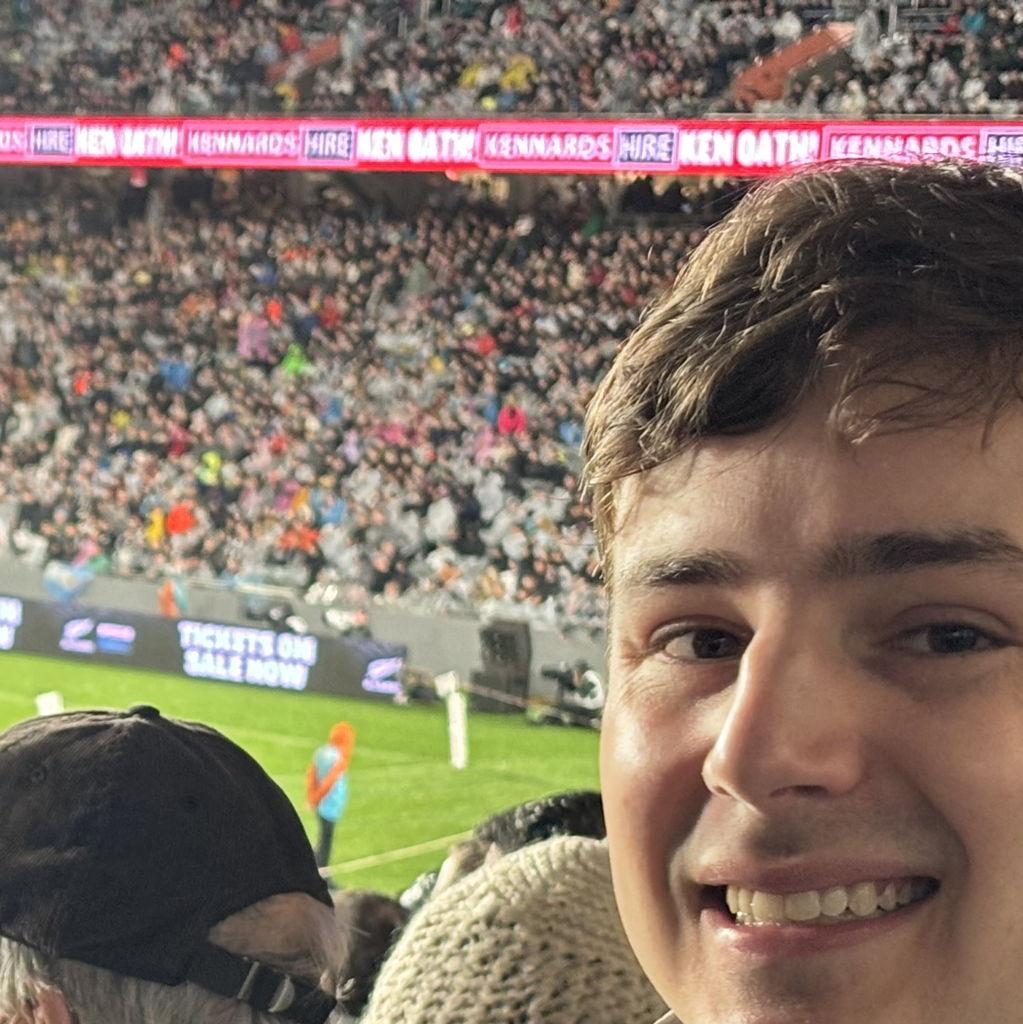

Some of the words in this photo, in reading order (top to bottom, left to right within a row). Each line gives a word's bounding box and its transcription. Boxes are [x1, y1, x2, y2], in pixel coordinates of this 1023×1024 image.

[484, 133, 611, 160] KENNARDS
[619, 132, 673, 162] HIRE
[679, 130, 734, 165] KEN
[178, 620, 276, 658] TICKETS
[278, 632, 317, 666] ON
[184, 650, 244, 683] SALE
[246, 659, 308, 690] NOW
